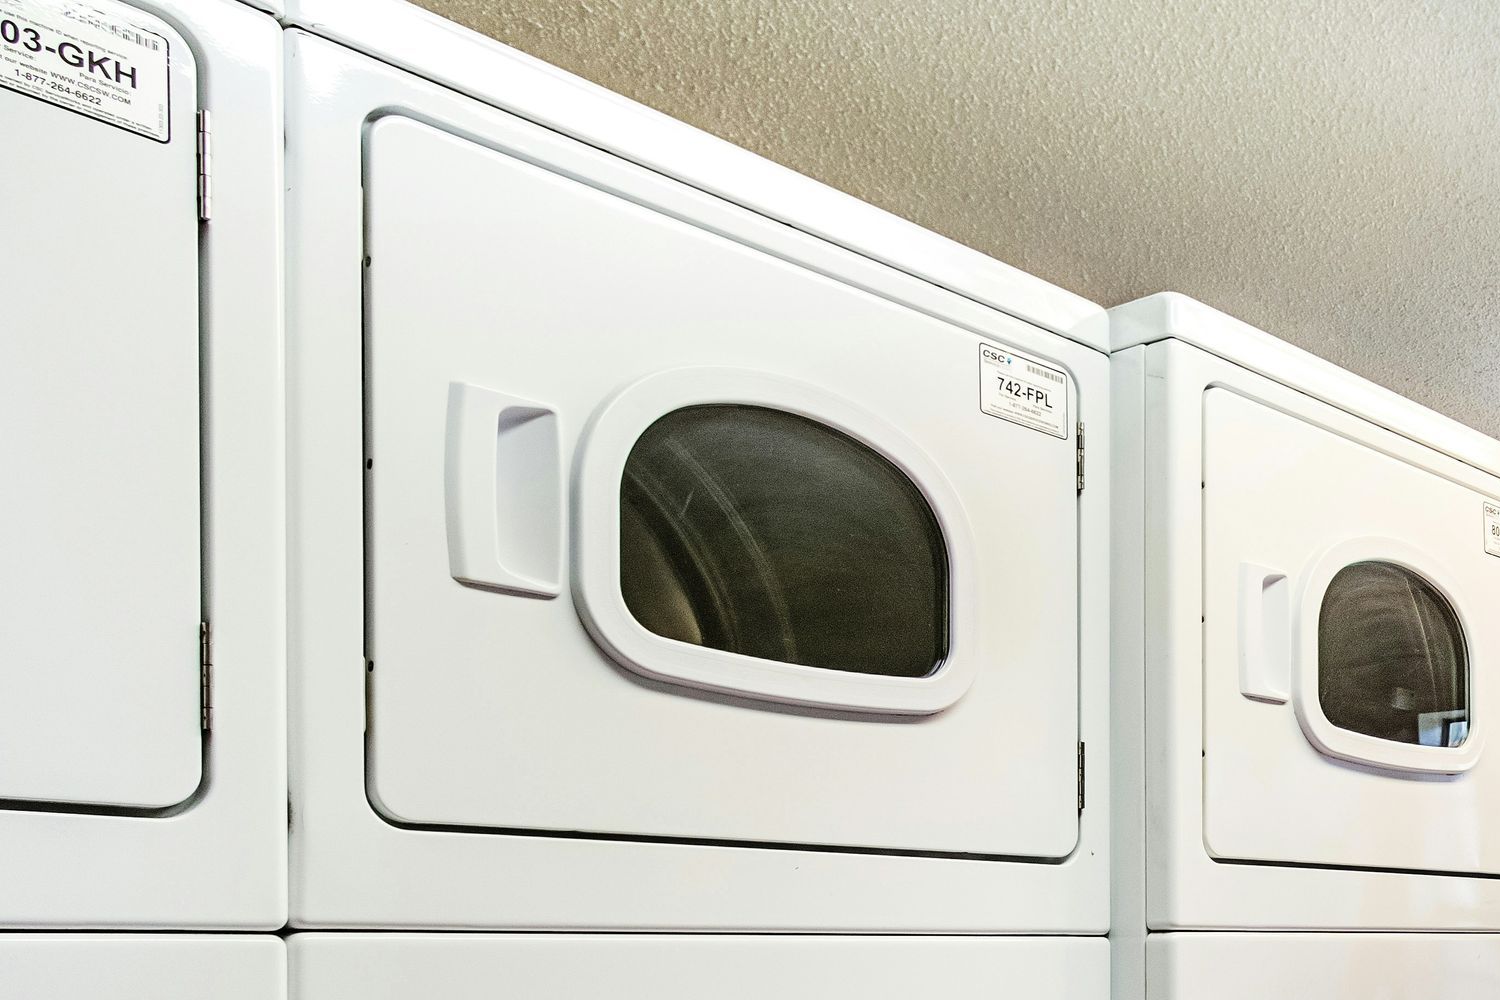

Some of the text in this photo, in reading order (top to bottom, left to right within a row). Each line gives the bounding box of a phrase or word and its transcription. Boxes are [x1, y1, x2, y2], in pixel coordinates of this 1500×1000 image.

[15, 68, 102, 106] 1-877-264-6622
[983, 349, 1005, 363] CSC
[997, 376, 1053, 409] 742-FPL
